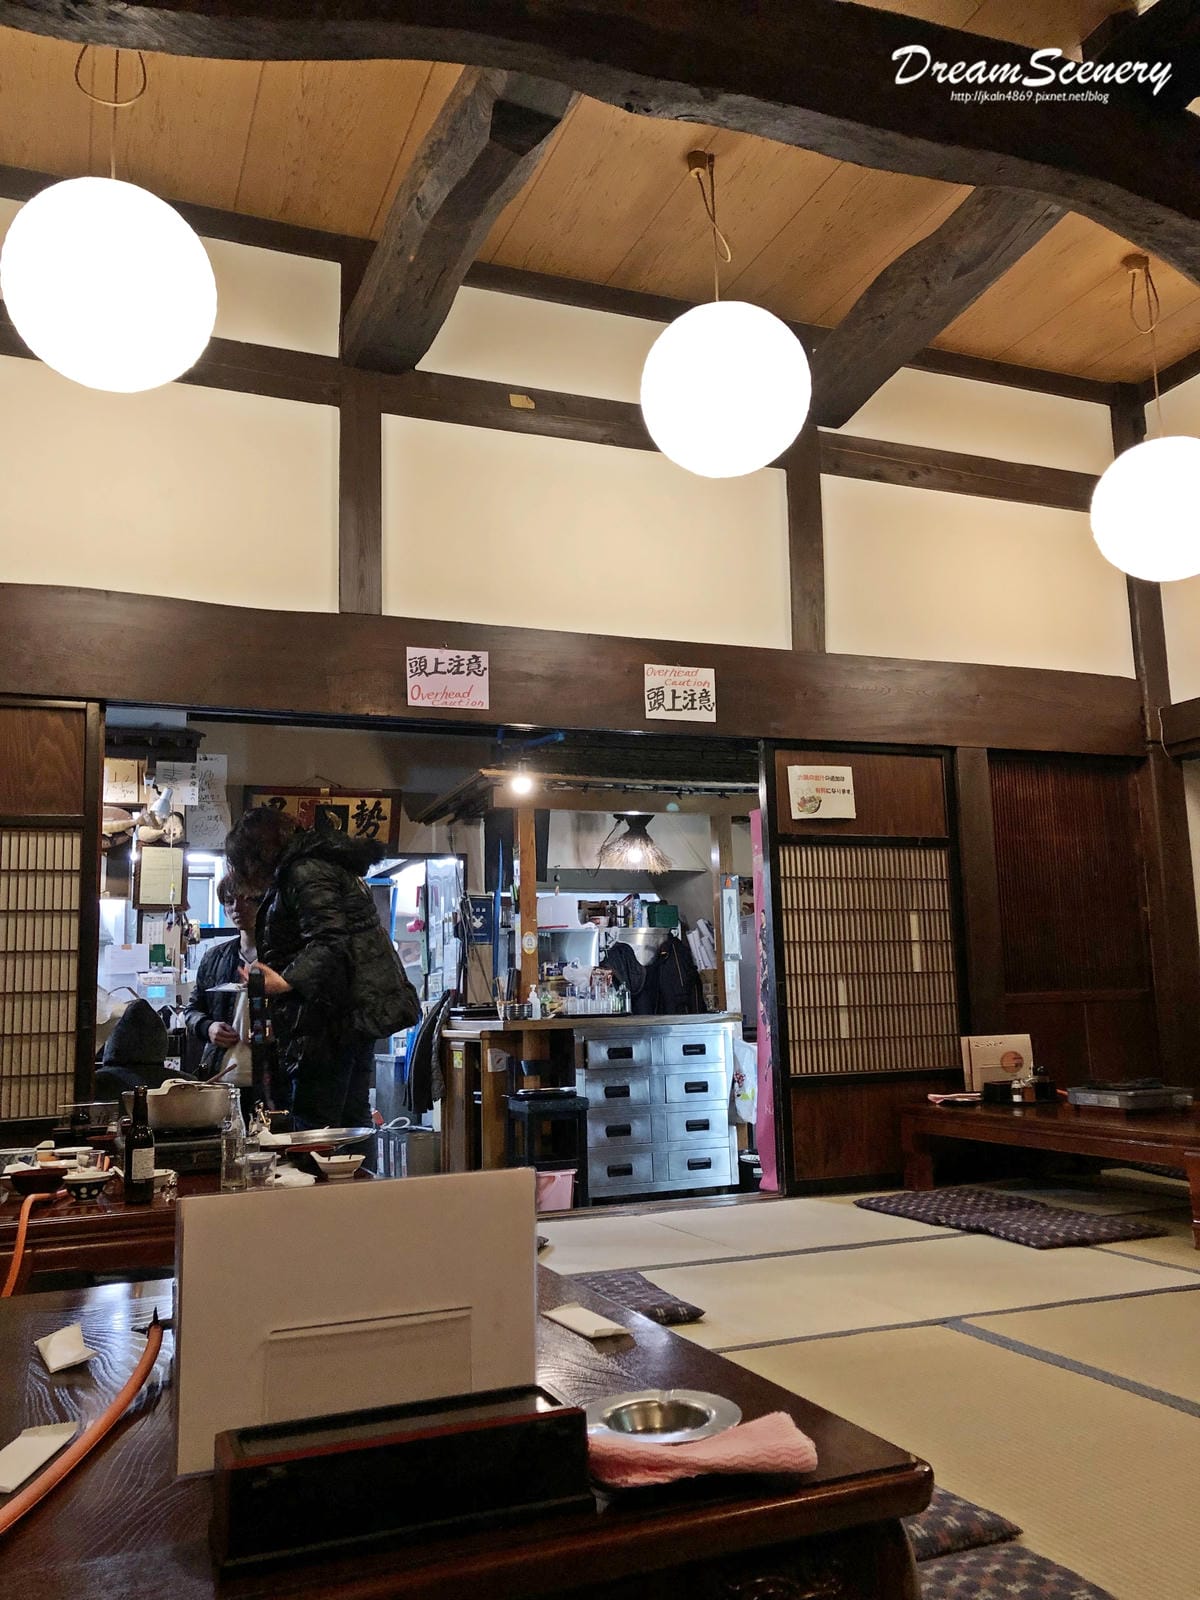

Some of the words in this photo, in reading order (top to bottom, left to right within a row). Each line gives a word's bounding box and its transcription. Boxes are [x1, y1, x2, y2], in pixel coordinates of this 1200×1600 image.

[408, 655, 487, 678] 頭上注意
[646, 667, 700, 677] Overhead
[410, 684, 474, 701] Overhead
[646, 686, 715, 712] 頭上注意
